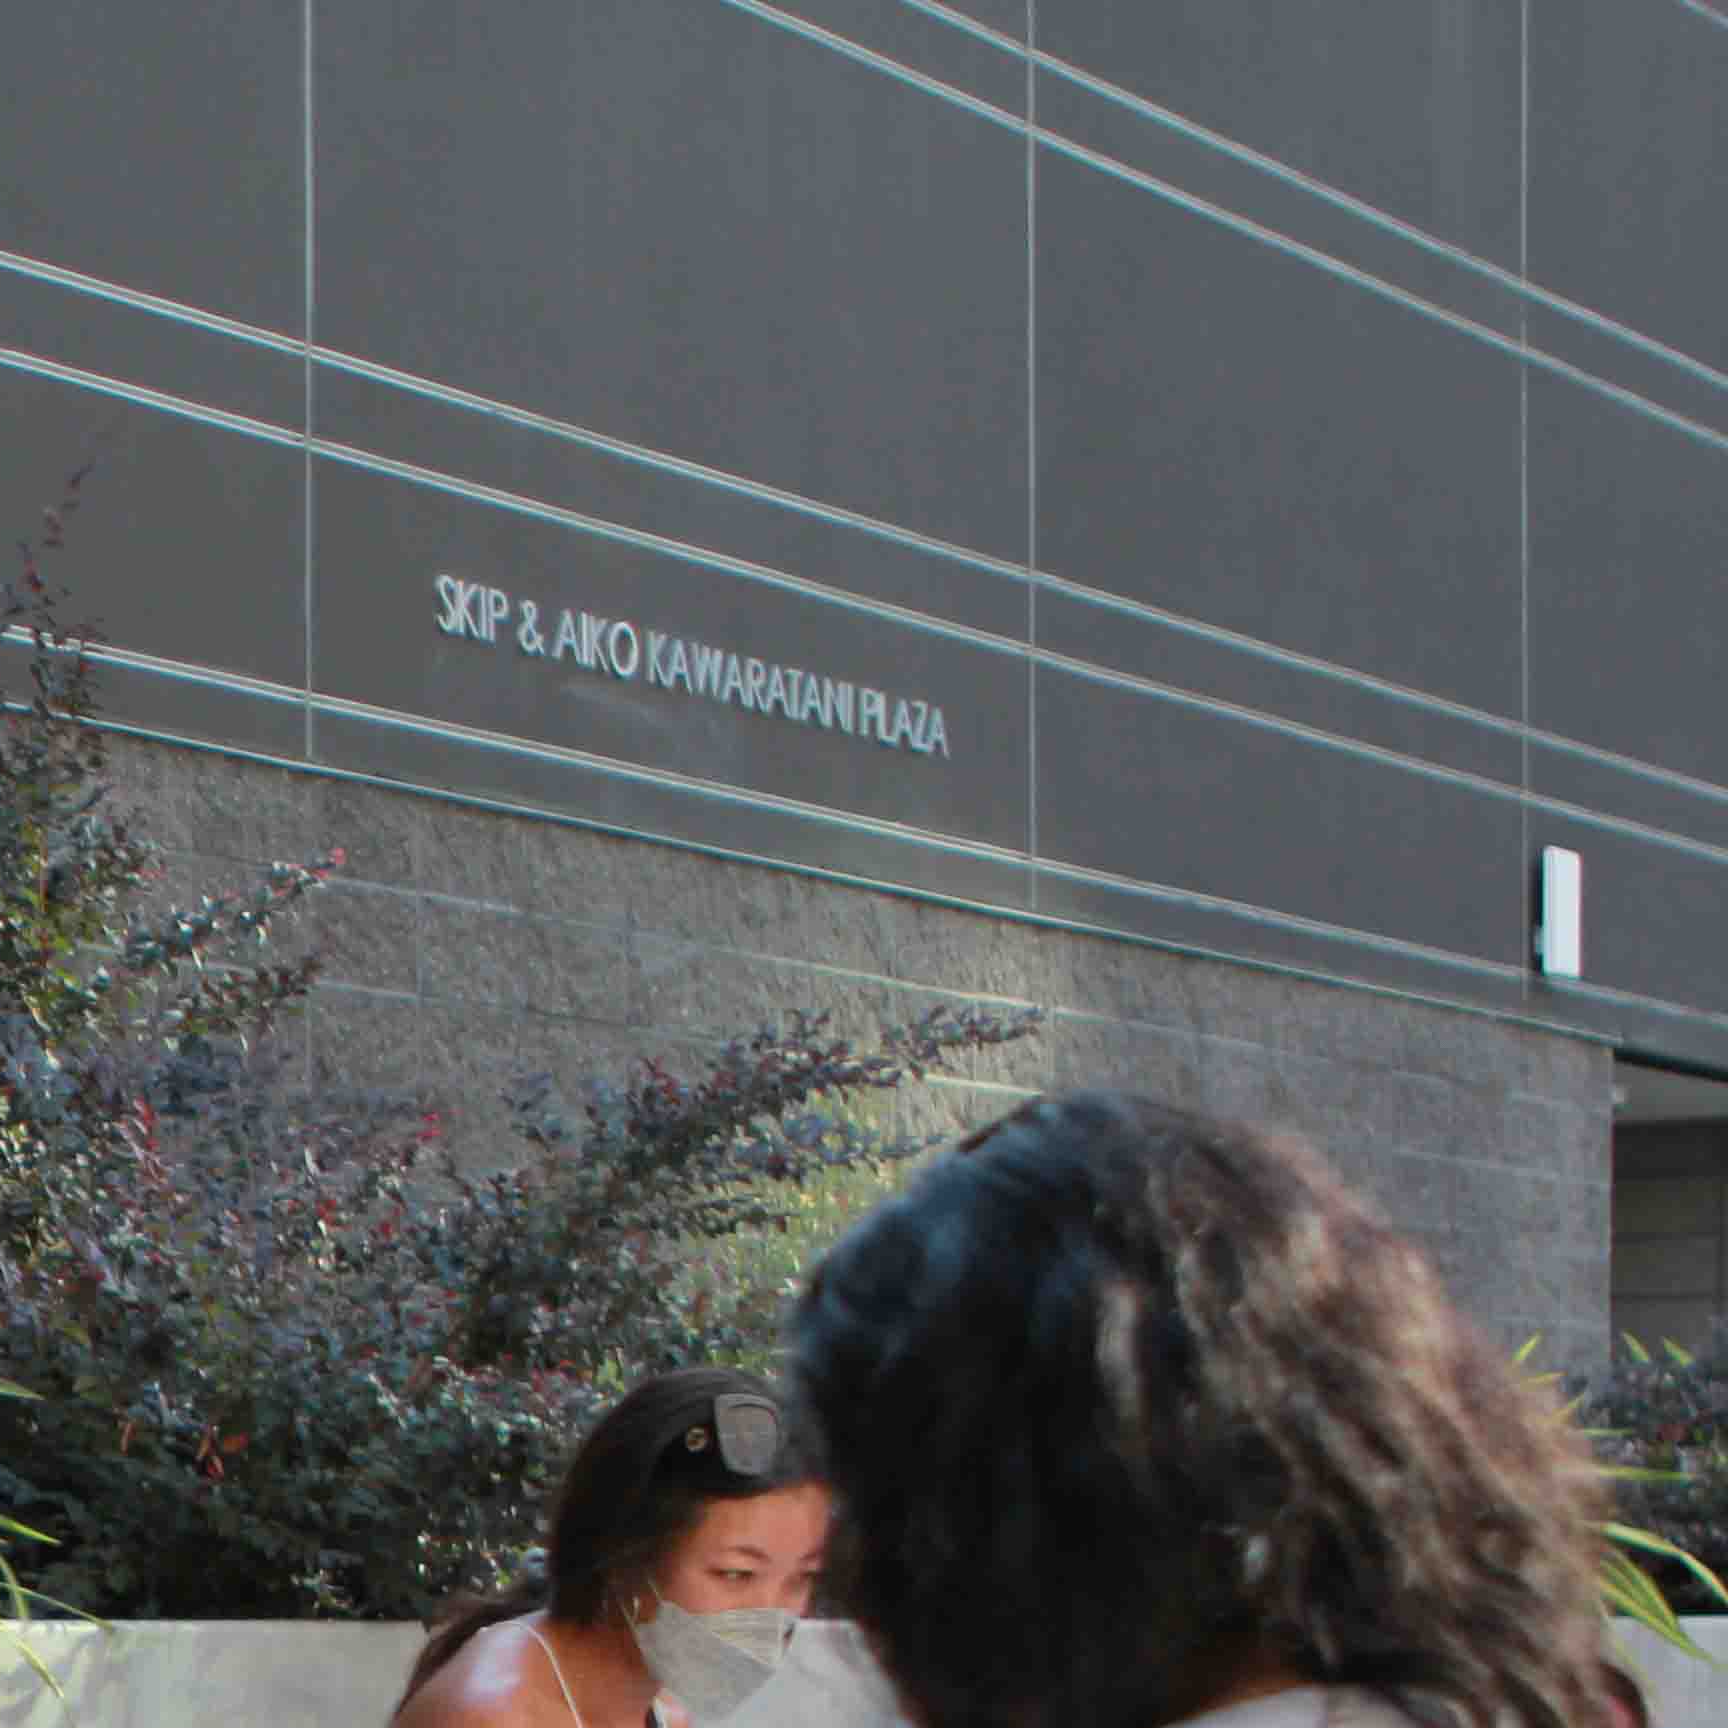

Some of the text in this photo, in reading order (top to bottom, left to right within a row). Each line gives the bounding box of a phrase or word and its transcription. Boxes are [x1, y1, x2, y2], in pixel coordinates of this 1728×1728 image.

[435, 573, 952, 759] SKIP & AIKO KAWARATANI PLAZA
